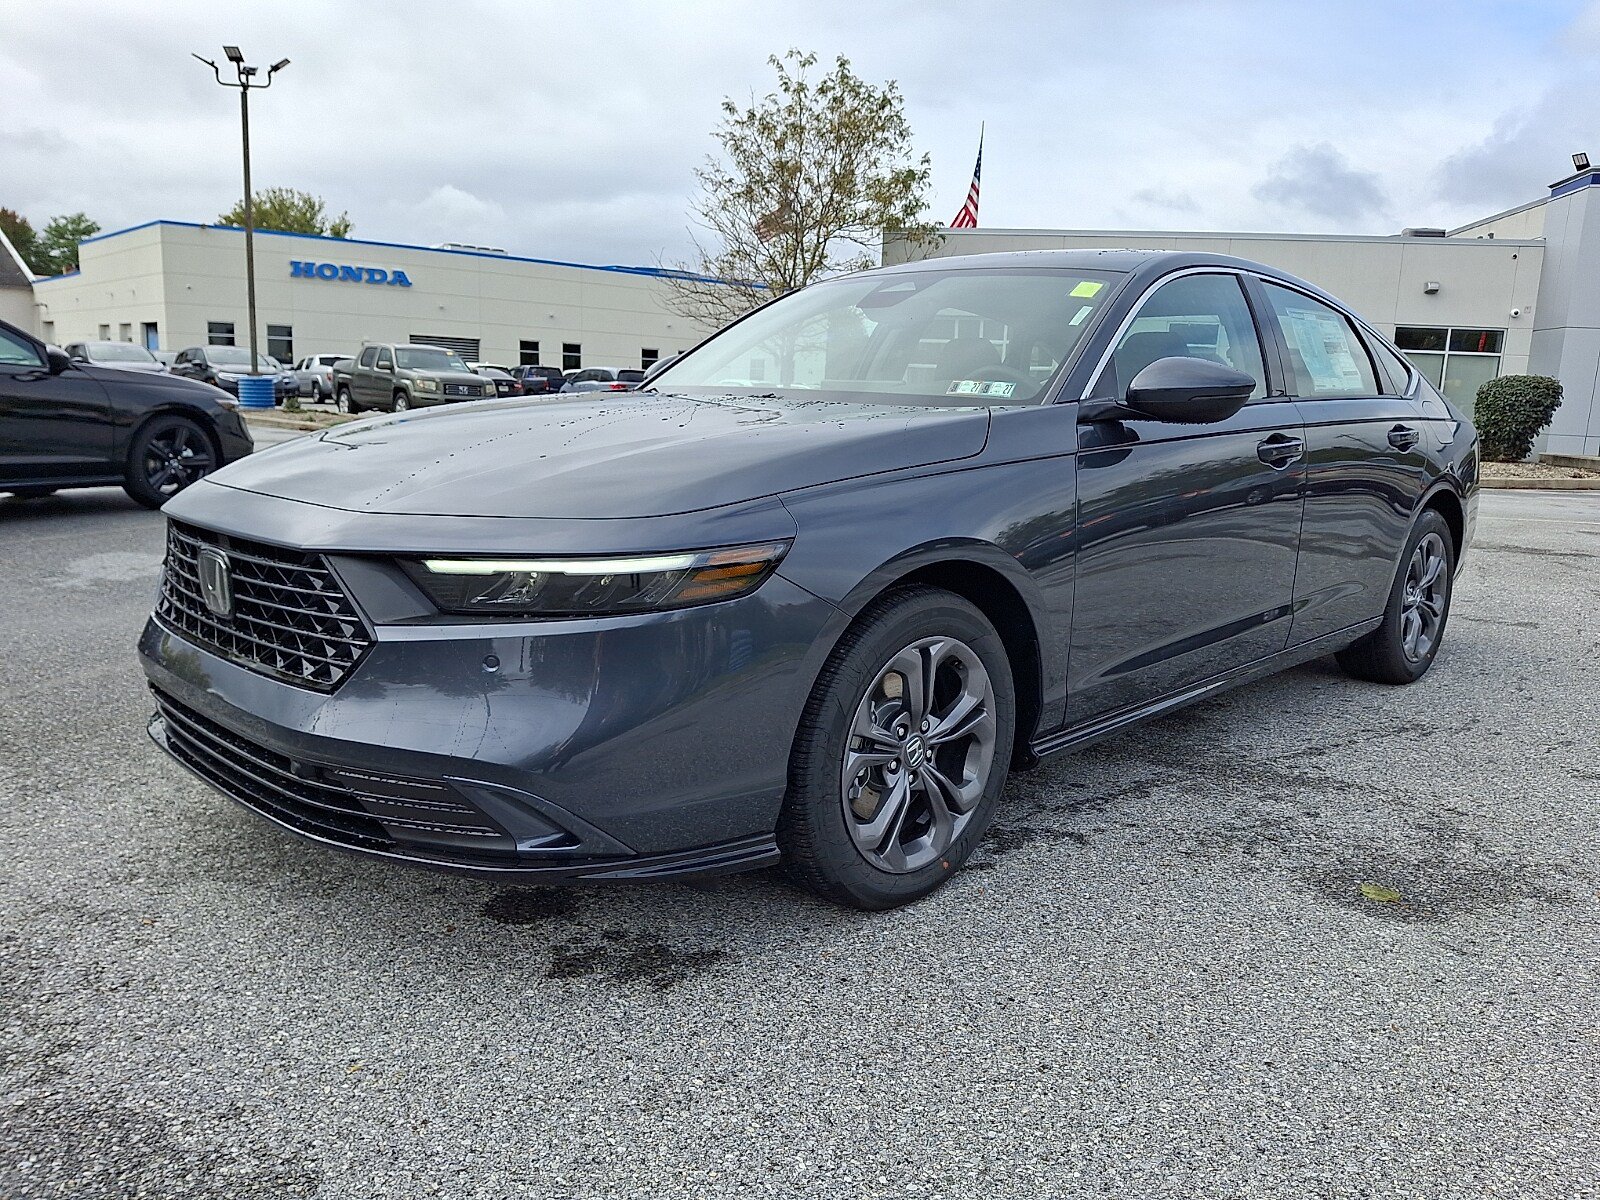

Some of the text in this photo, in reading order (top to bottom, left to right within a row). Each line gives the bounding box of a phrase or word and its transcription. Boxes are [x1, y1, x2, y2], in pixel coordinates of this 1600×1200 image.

[290, 260, 412, 287] HONDA
[970, 382, 981, 392] 27
[1002, 384, 1014, 394] 27
